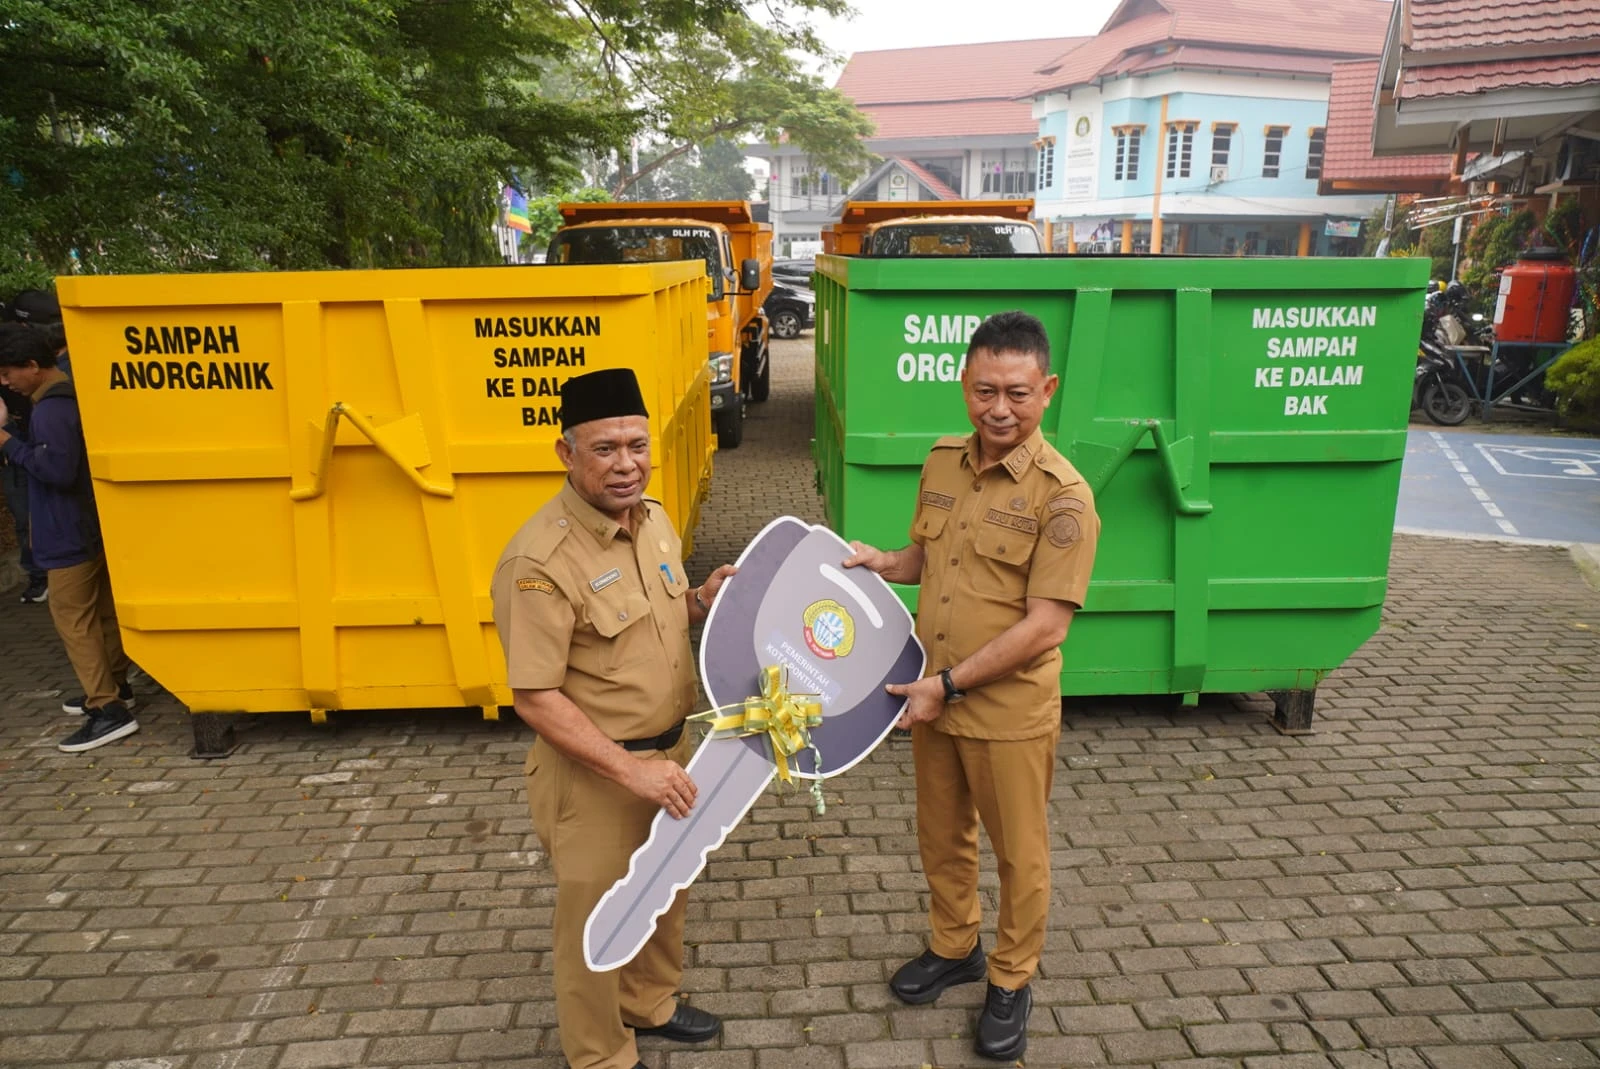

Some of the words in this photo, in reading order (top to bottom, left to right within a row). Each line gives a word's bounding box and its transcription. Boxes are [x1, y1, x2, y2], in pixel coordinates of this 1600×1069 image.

[672, 229, 690, 237] DLH
[692, 229, 711, 238] PTK
[474, 316, 601, 338] MASUKKAN
[903, 314, 987, 344] SAMP
[1252, 306, 1377, 329] MASUKKAN
[124, 326, 240, 355] SAMPAH
[1266, 335, 1358, 359] SAMPAH
[493, 346, 586, 368] SAMPAH
[110, 361, 274, 390] ANORGANIK
[1254, 367, 1284, 388] KE
[1289, 365, 1363, 387] DALAM
[486, 378, 516, 398] KE
[521, 377, 570, 397] DAL
[521, 406, 563, 426] BAK
[1284, 395, 1329, 416] BAK
[766, 643, 790, 668] KOTA
[780, 640, 830, 688] PEMERINTAH
